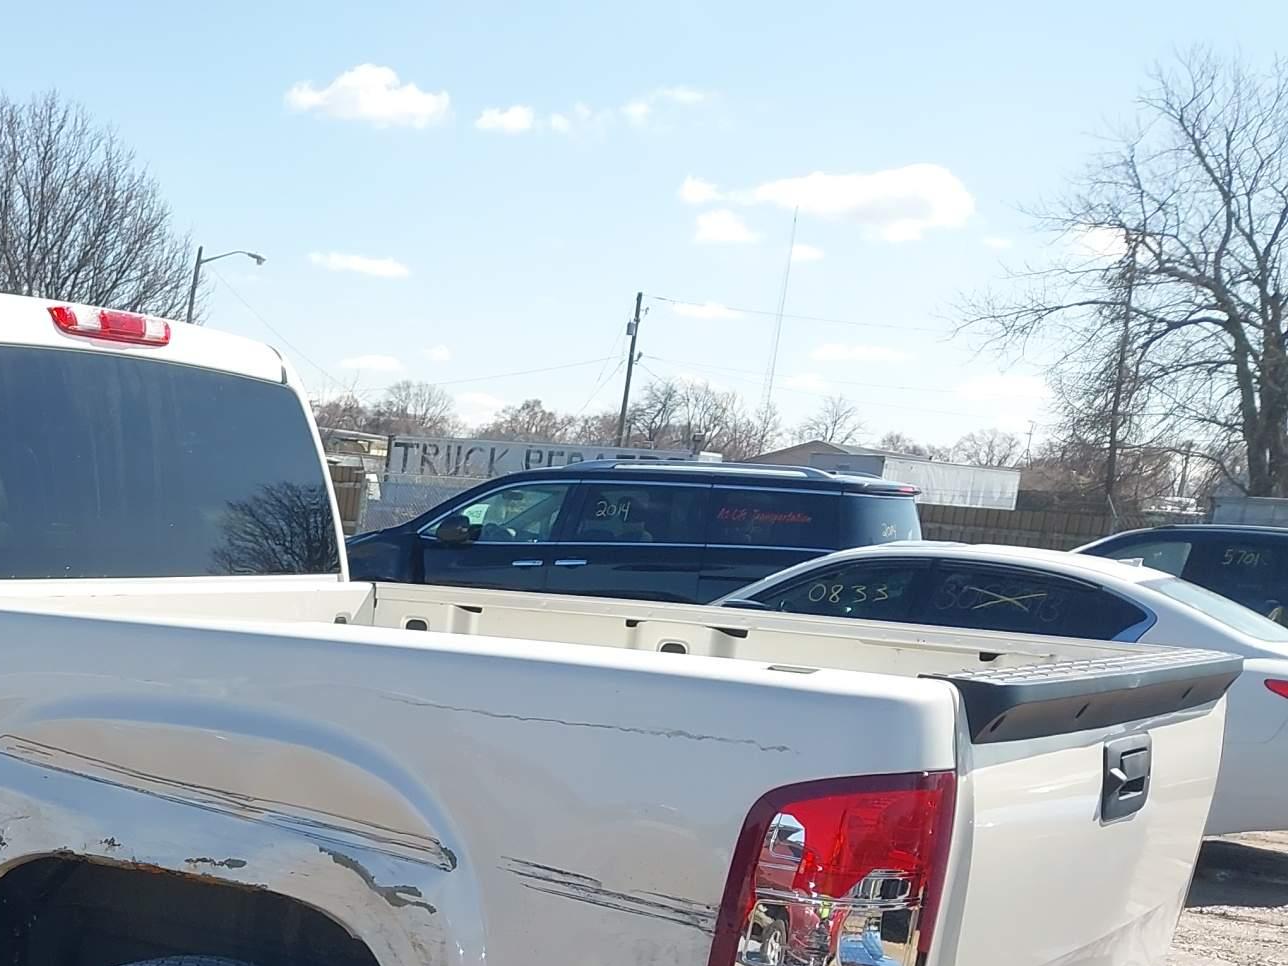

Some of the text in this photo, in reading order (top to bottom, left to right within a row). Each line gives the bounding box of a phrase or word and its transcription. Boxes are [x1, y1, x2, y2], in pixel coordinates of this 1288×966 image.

[394, 442, 511, 478] TRUCK
[595, 501, 631, 521] 2014
[809, 584, 888, 603] 0833
